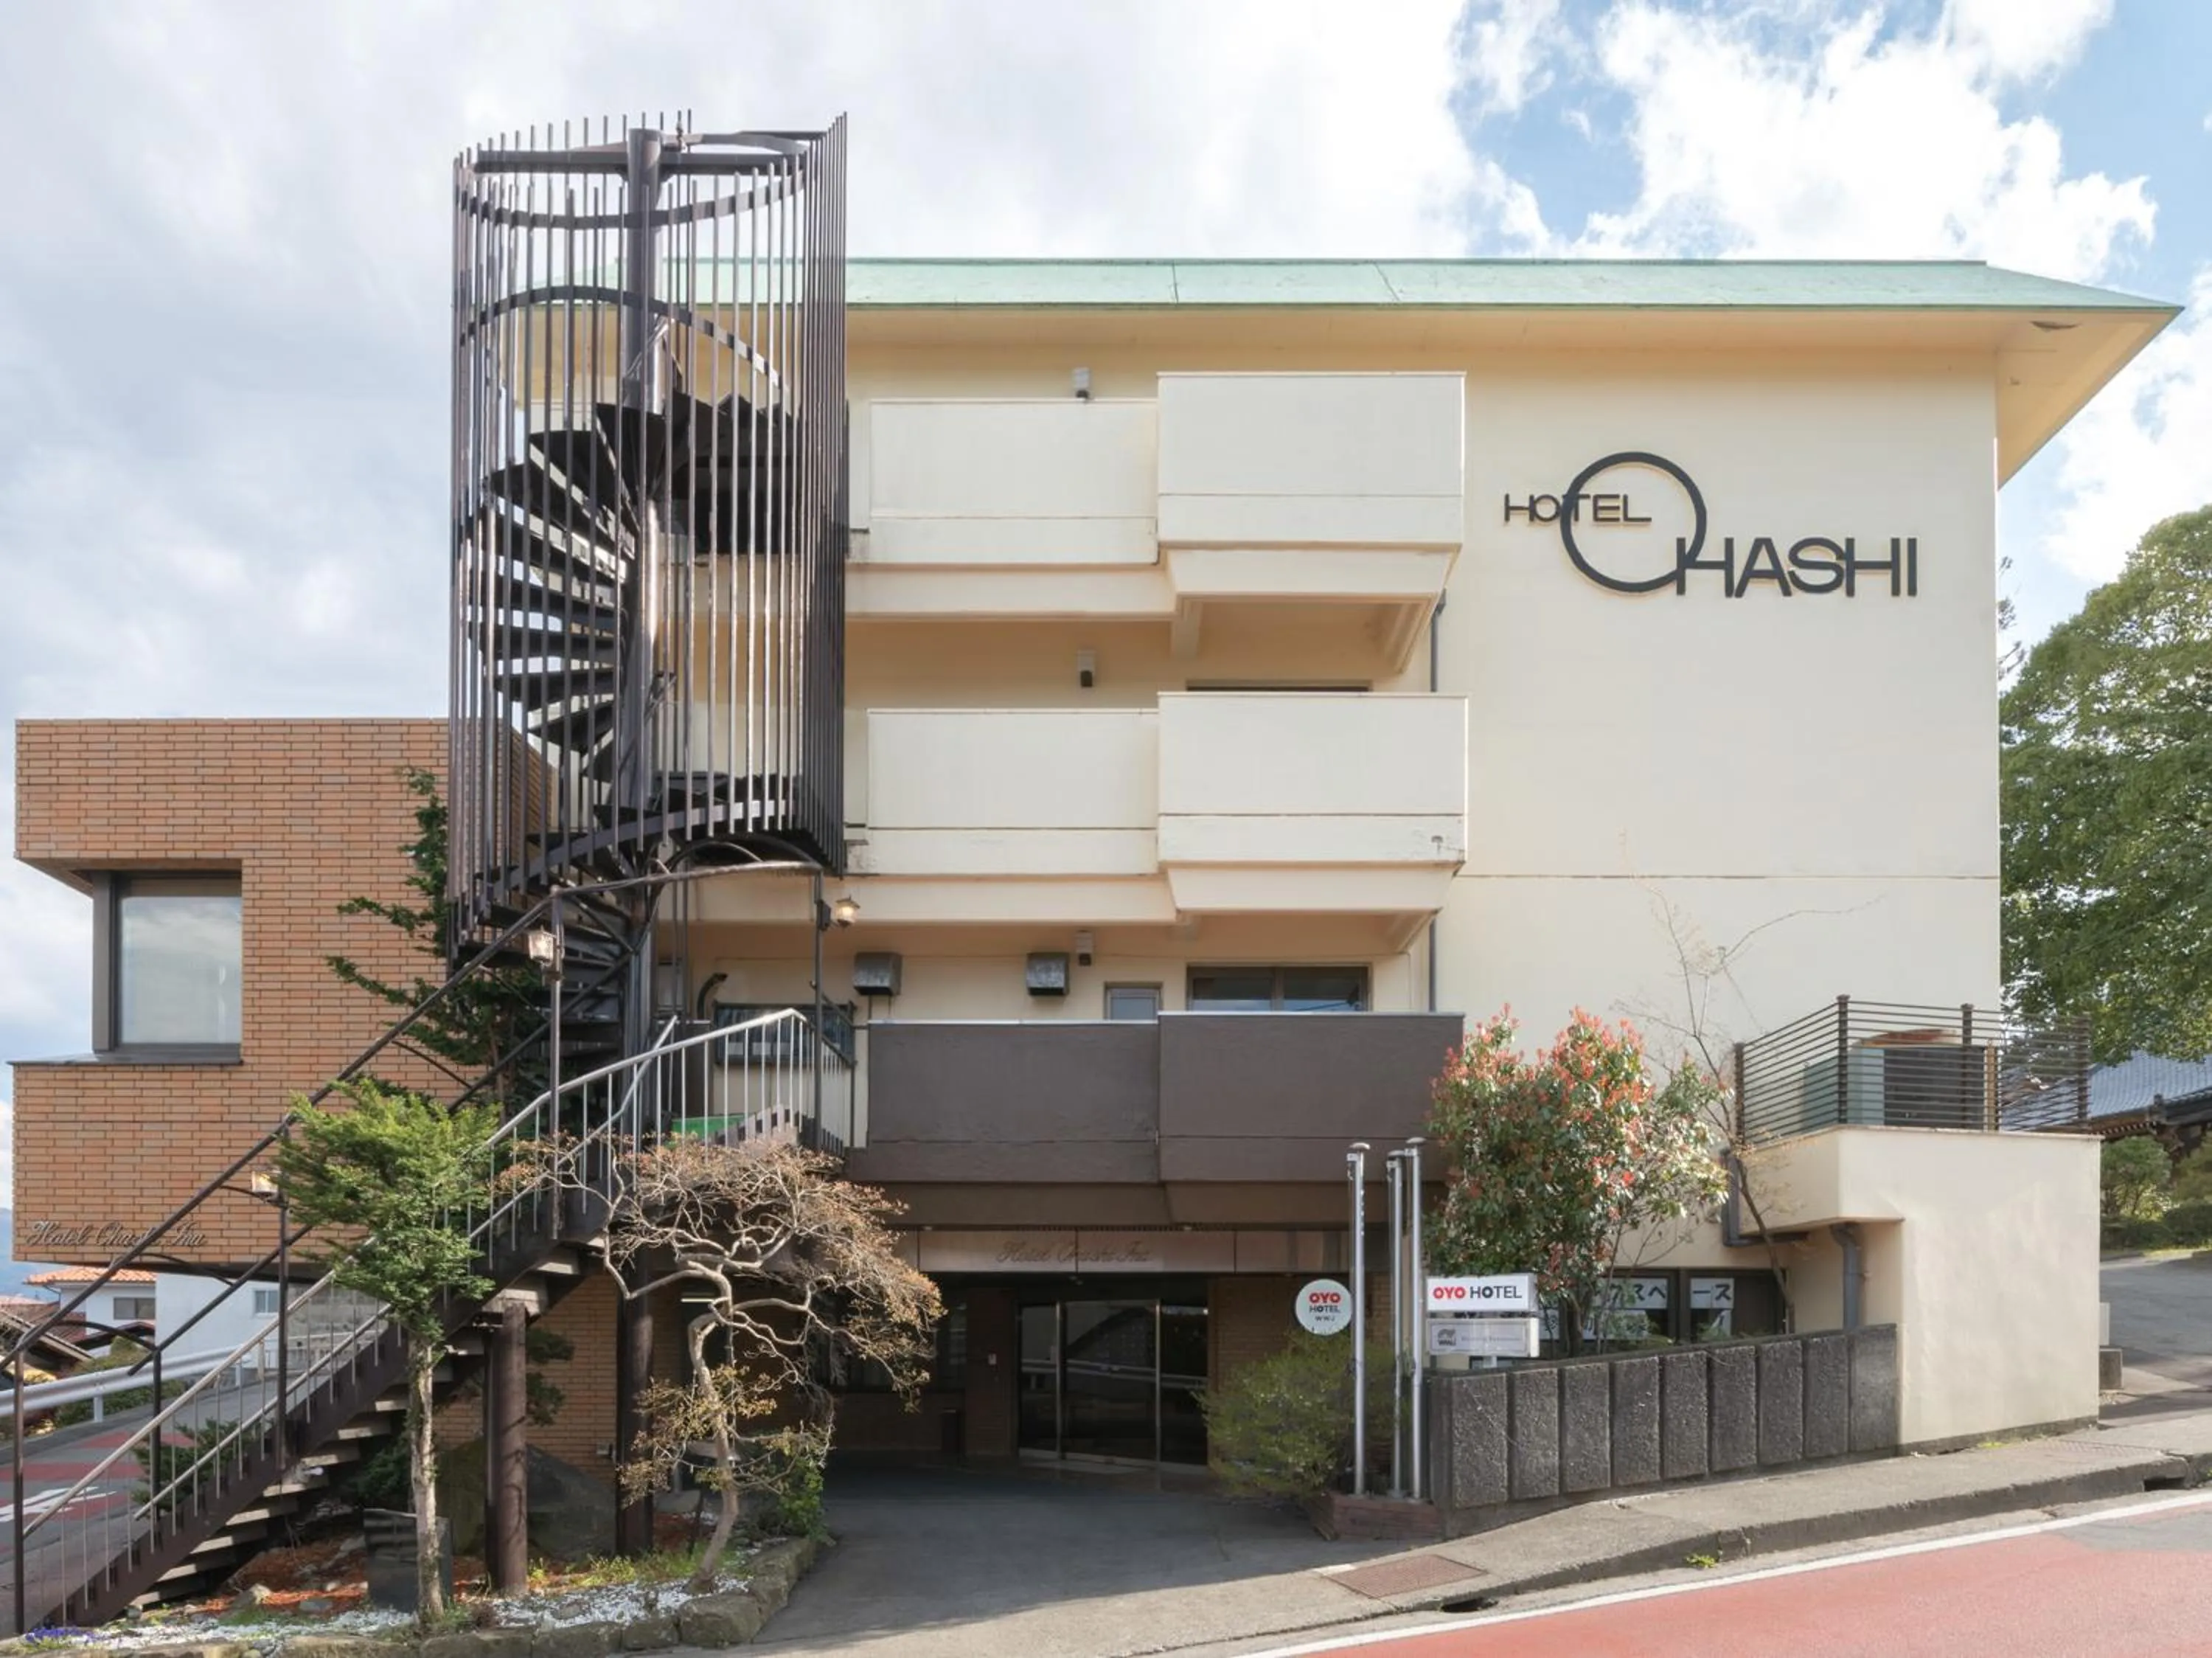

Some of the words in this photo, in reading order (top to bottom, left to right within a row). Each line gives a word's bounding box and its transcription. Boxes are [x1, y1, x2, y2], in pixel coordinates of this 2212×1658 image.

[1504, 493, 1652, 522] HOTEL
[1560, 451, 1917, 598] OHASHI
[1309, 1292, 1340, 1303] OYO
[1433, 1286, 1466, 1300] OYO
[1470, 1286, 1523, 1299] HOTEL
[1309, 1305, 1342, 1314] HOTEL
